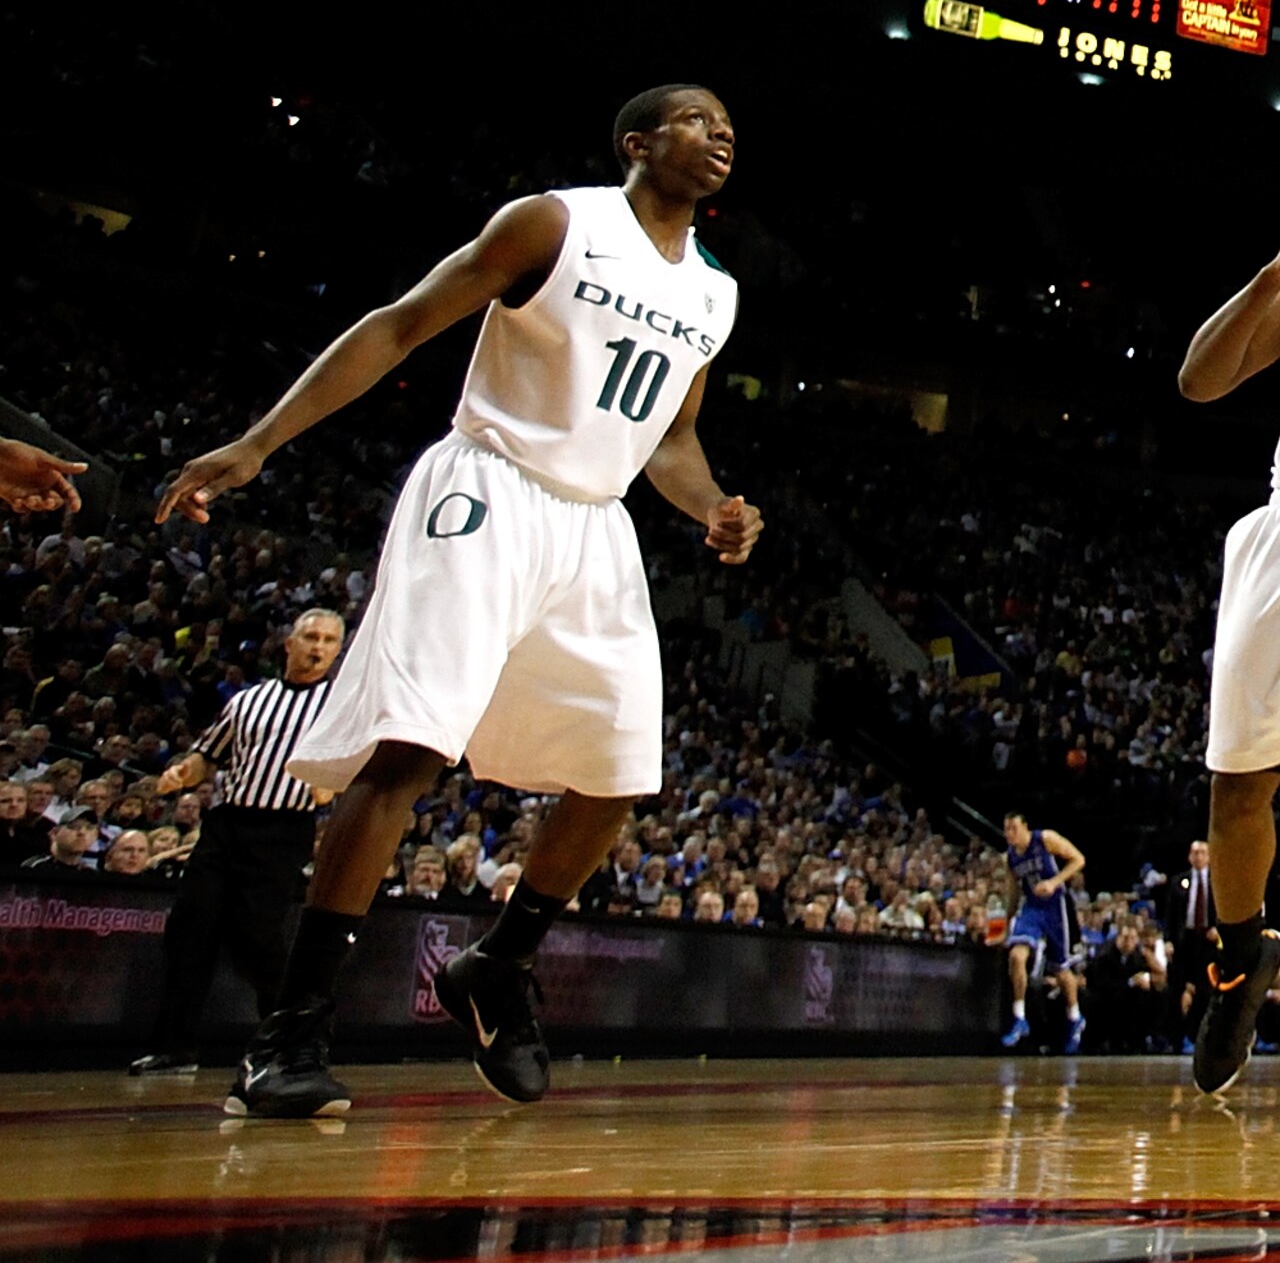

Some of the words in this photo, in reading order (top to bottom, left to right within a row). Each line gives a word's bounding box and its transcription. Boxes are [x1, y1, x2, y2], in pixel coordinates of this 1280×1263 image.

[1182, 9, 1231, 36] CAPTAIN
[573, 280, 717, 358] DUCKS
[595, 336, 671, 423] 10
